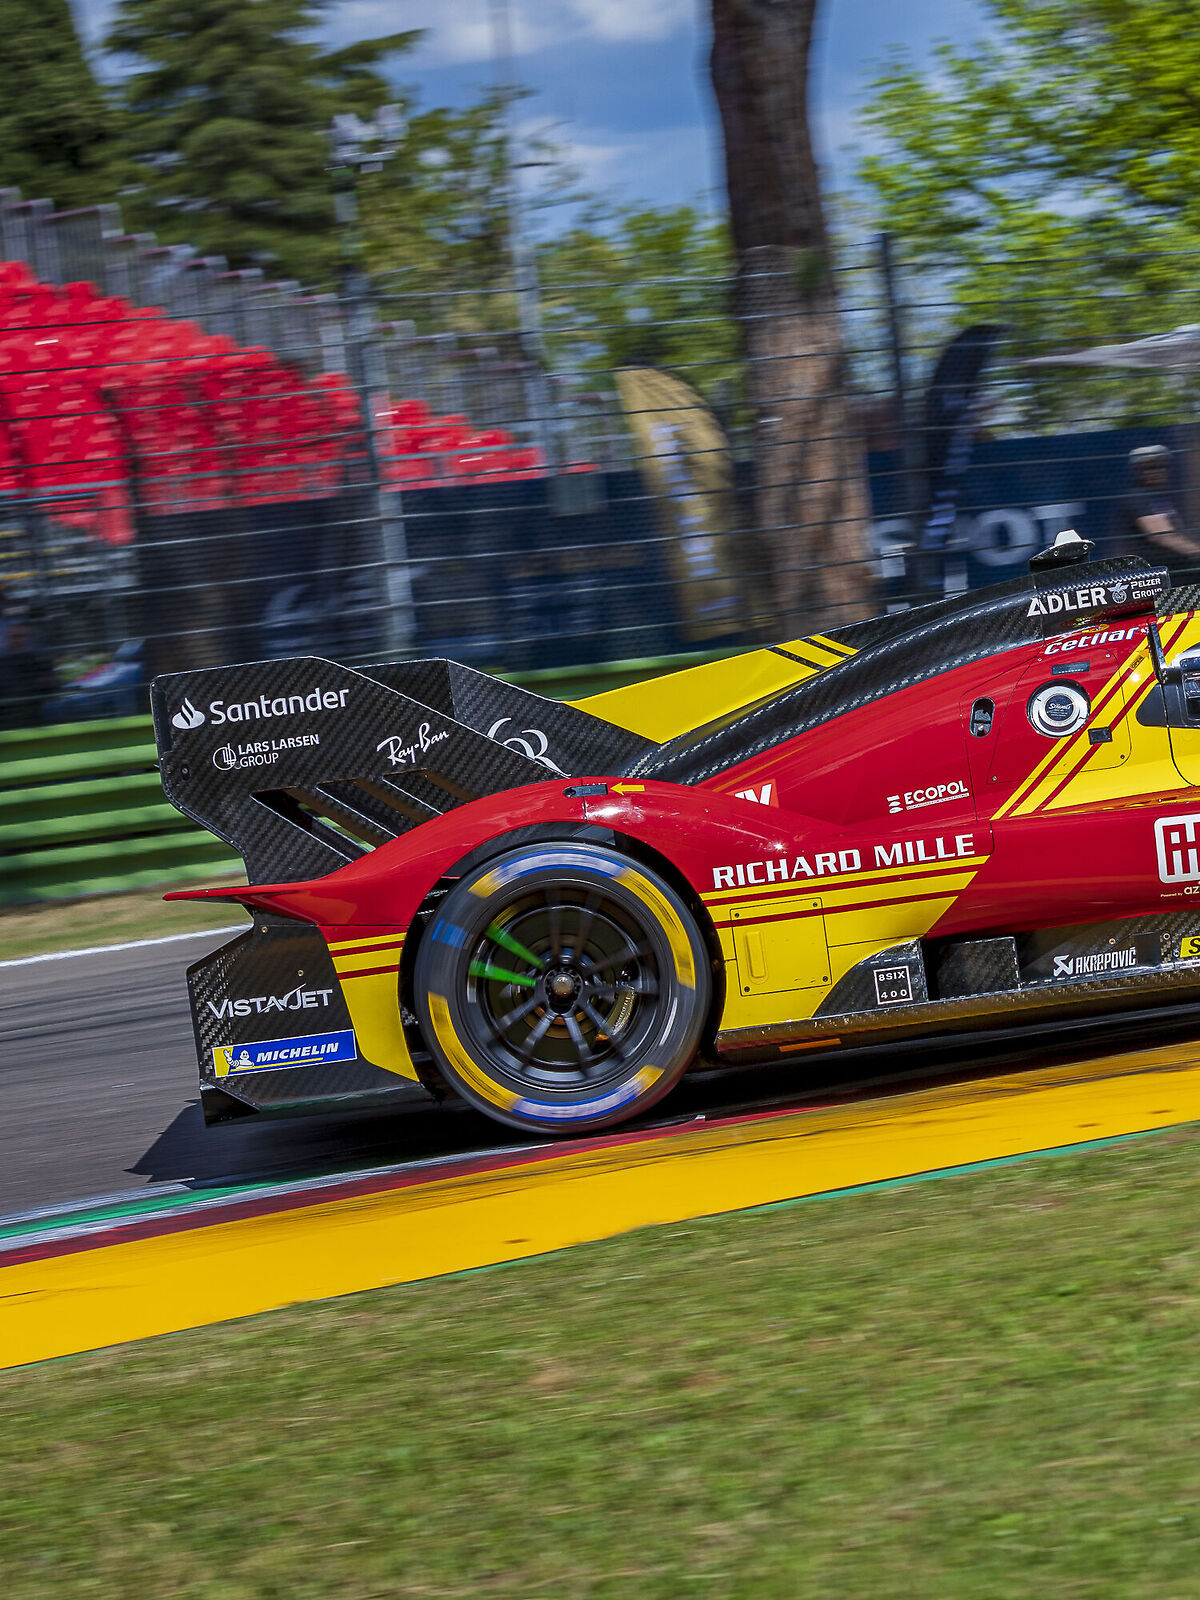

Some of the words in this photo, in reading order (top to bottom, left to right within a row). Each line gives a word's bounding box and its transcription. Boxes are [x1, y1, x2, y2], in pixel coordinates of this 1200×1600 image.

[1130, 578, 1161, 590] PELZER
[1027, 587, 1108, 617] ADLER
[210, 687, 350, 726] Santander
[238, 741, 270, 756] LARS
[272, 734, 320, 751] LARSEN
[240, 753, 279, 768] GROUP
[904, 780, 969, 805] ECOPOL
[712, 849, 861, 889] RICHARD
[874, 833, 976, 868] MILLE
[879, 970, 906, 982] 8SIX
[256, 1042, 339, 1063] MICHELIN
